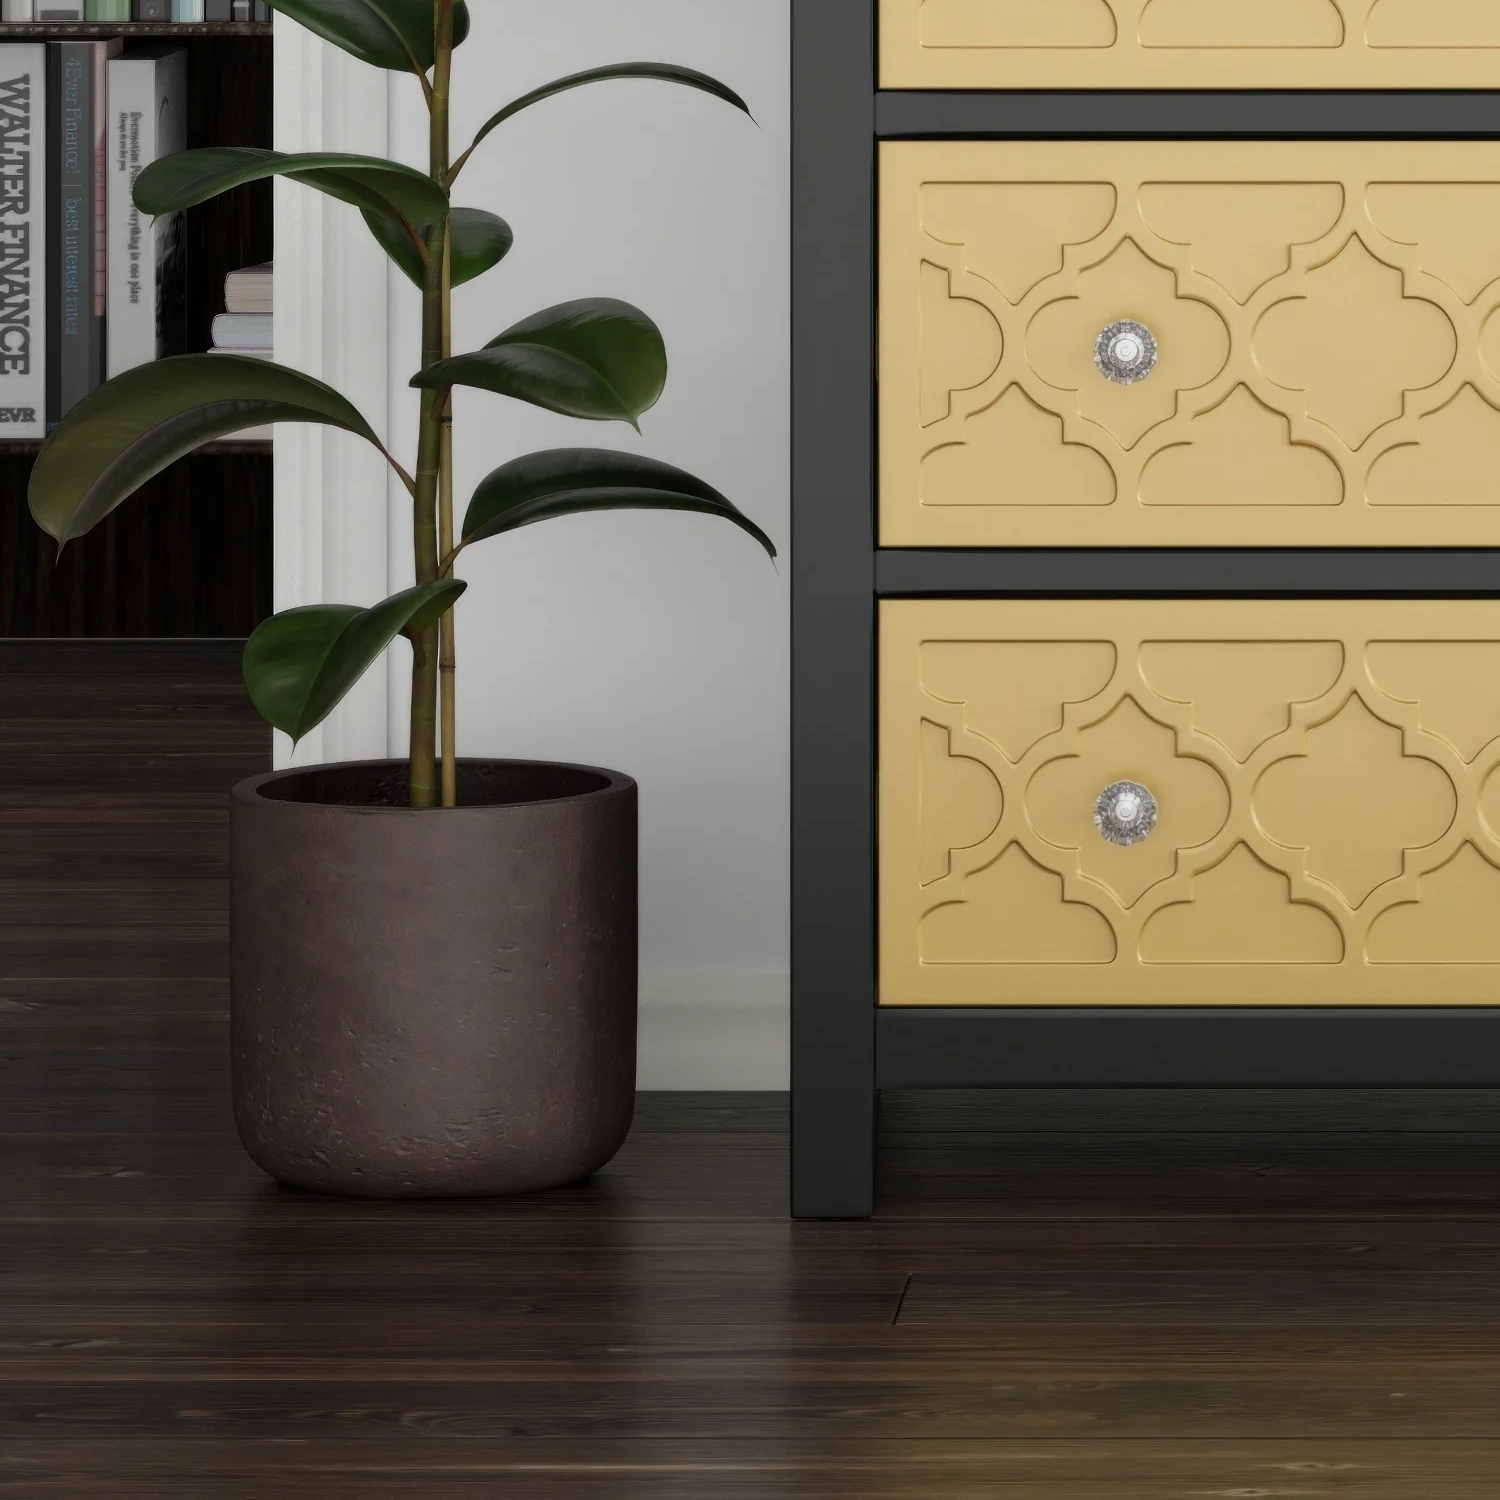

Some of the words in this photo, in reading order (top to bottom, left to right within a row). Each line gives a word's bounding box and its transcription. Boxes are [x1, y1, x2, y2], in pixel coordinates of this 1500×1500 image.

[0, 73, 30, 217] WALTER
[65, 107, 82, 176] Finance!
[65, 197, 82, 232] best
[65, 235, 82, 293] interest
[0, 221, 30, 375] FINANCE
[65, 296, 80, 335] rates
[0, 408, 37, 423] EVR
